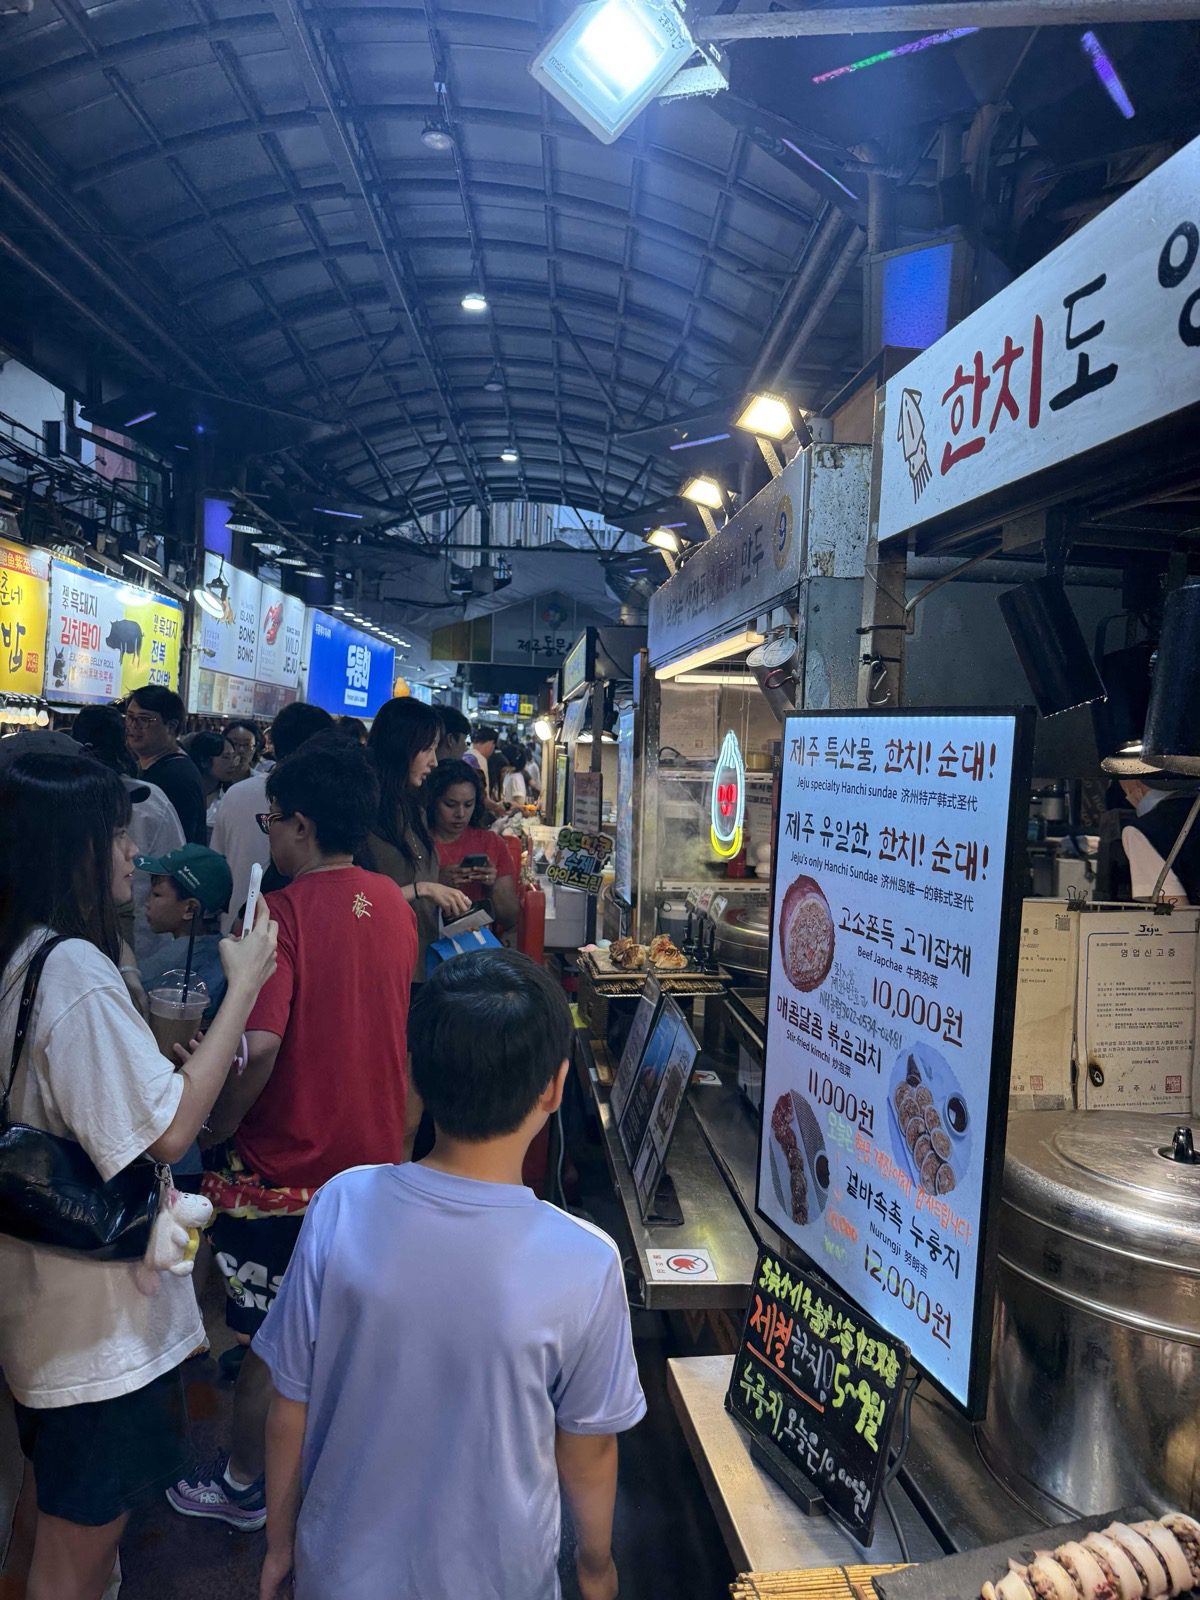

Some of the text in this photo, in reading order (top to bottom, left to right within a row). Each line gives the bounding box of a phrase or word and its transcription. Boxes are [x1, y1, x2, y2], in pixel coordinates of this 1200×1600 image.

[70, 588, 98, 618] 흑돼지
[61, 616, 101, 652] 김치말이
[159, 616, 178, 640] 흑돼지
[239, 625, 255, 644] BONG
[285, 635, 299, 656] WILD
[151, 639, 166, 666] 전복
[237, 645, 253, 663] BONG
[517, 636, 574, 656] 제주동문
[283, 656, 298, 674] JEJU
[790, 736, 996, 781] 제주 특산물, 한치! 순대!
[797, 778, 978, 812] Jeju specialty Hanchi sundae 济州特产韩式圣代
[564, 852, 595, 874] 수제
[785, 811, 989, 882] 제주 유일한, 한치! 순대!
[547, 866, 602, 893] 아이스크림
[790, 851, 974, 912] Jeju's only Hanchi Sundae 济州岛唯一的韩式圣代
[838, 907, 895, 950] 고소쫀득
[901, 927, 971, 977] 고기잡채
[1139, 924, 1159, 936] Jeju
[857, 946, 939, 989] Beef Japchae 牛肉杂菜
[872, 976, 963, 1047] 10,000원
[776, 995, 881, 1074] 매콤달콤 볶음김치
[786, 1029, 810, 1052] Stir-fried
[810, 1043, 831, 1064] kimchi
[808, 1068, 874, 1138] 11,000원
[846, 1165, 903, 1234] 겉바속촉
[909, 1216, 960, 1279] 누룽지
[870, 1221, 901, 1256] Nurungji
[864, 1244, 951, 1349] 12,000원
